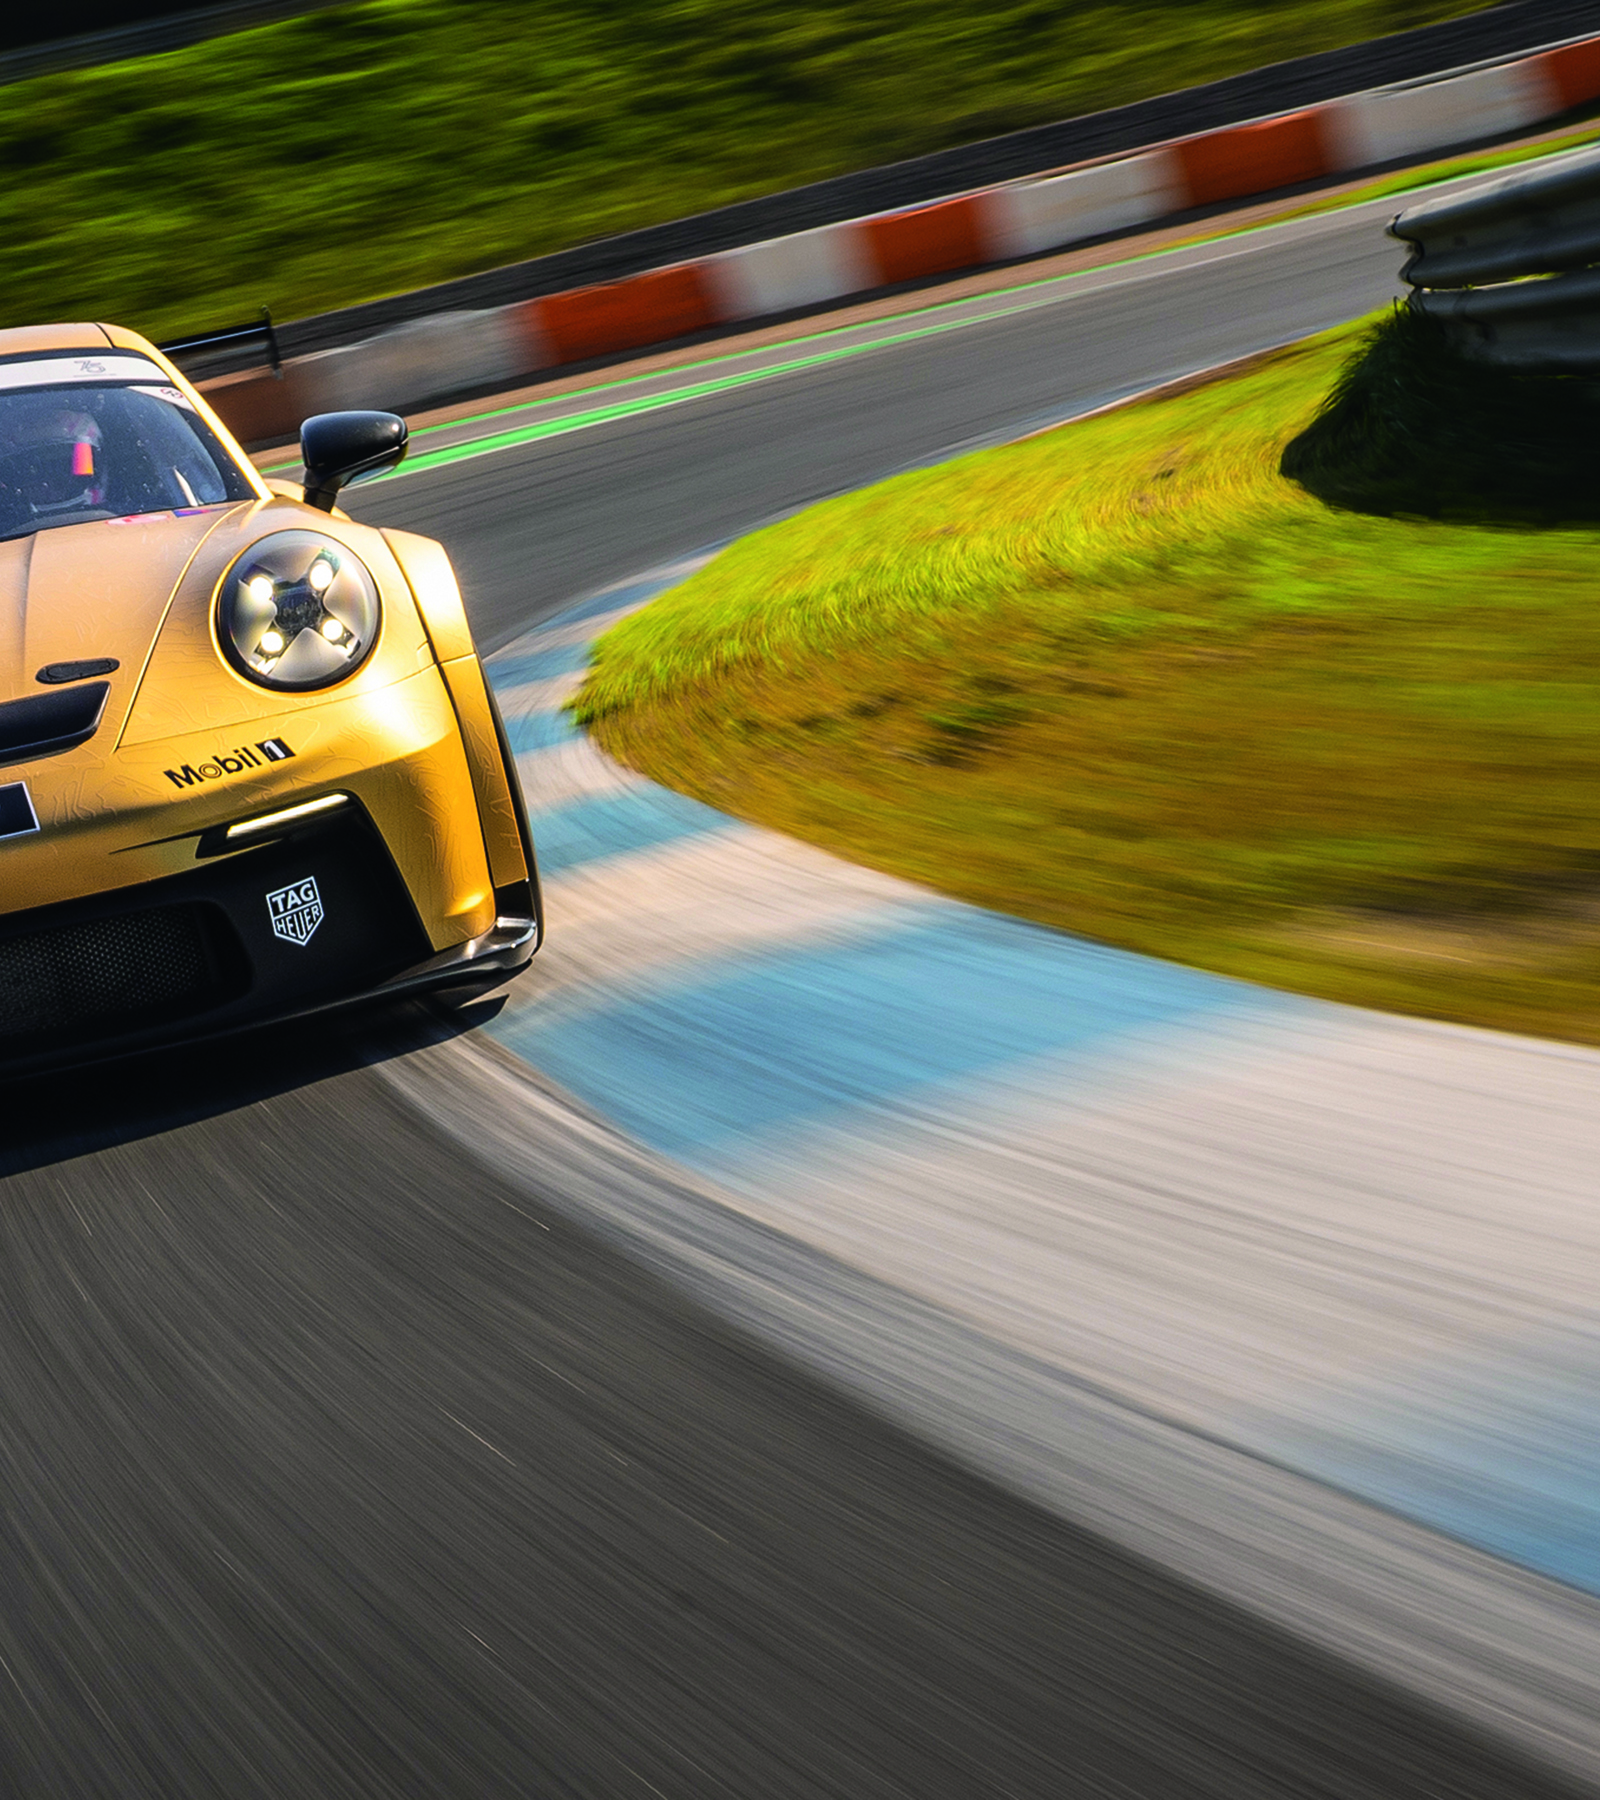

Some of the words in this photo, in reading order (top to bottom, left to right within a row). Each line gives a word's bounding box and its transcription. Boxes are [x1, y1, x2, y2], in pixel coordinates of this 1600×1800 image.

[163, 746, 262, 789] Mobil
[271, 883, 315, 913] TAG
[276, 904, 320, 940] HEUER
